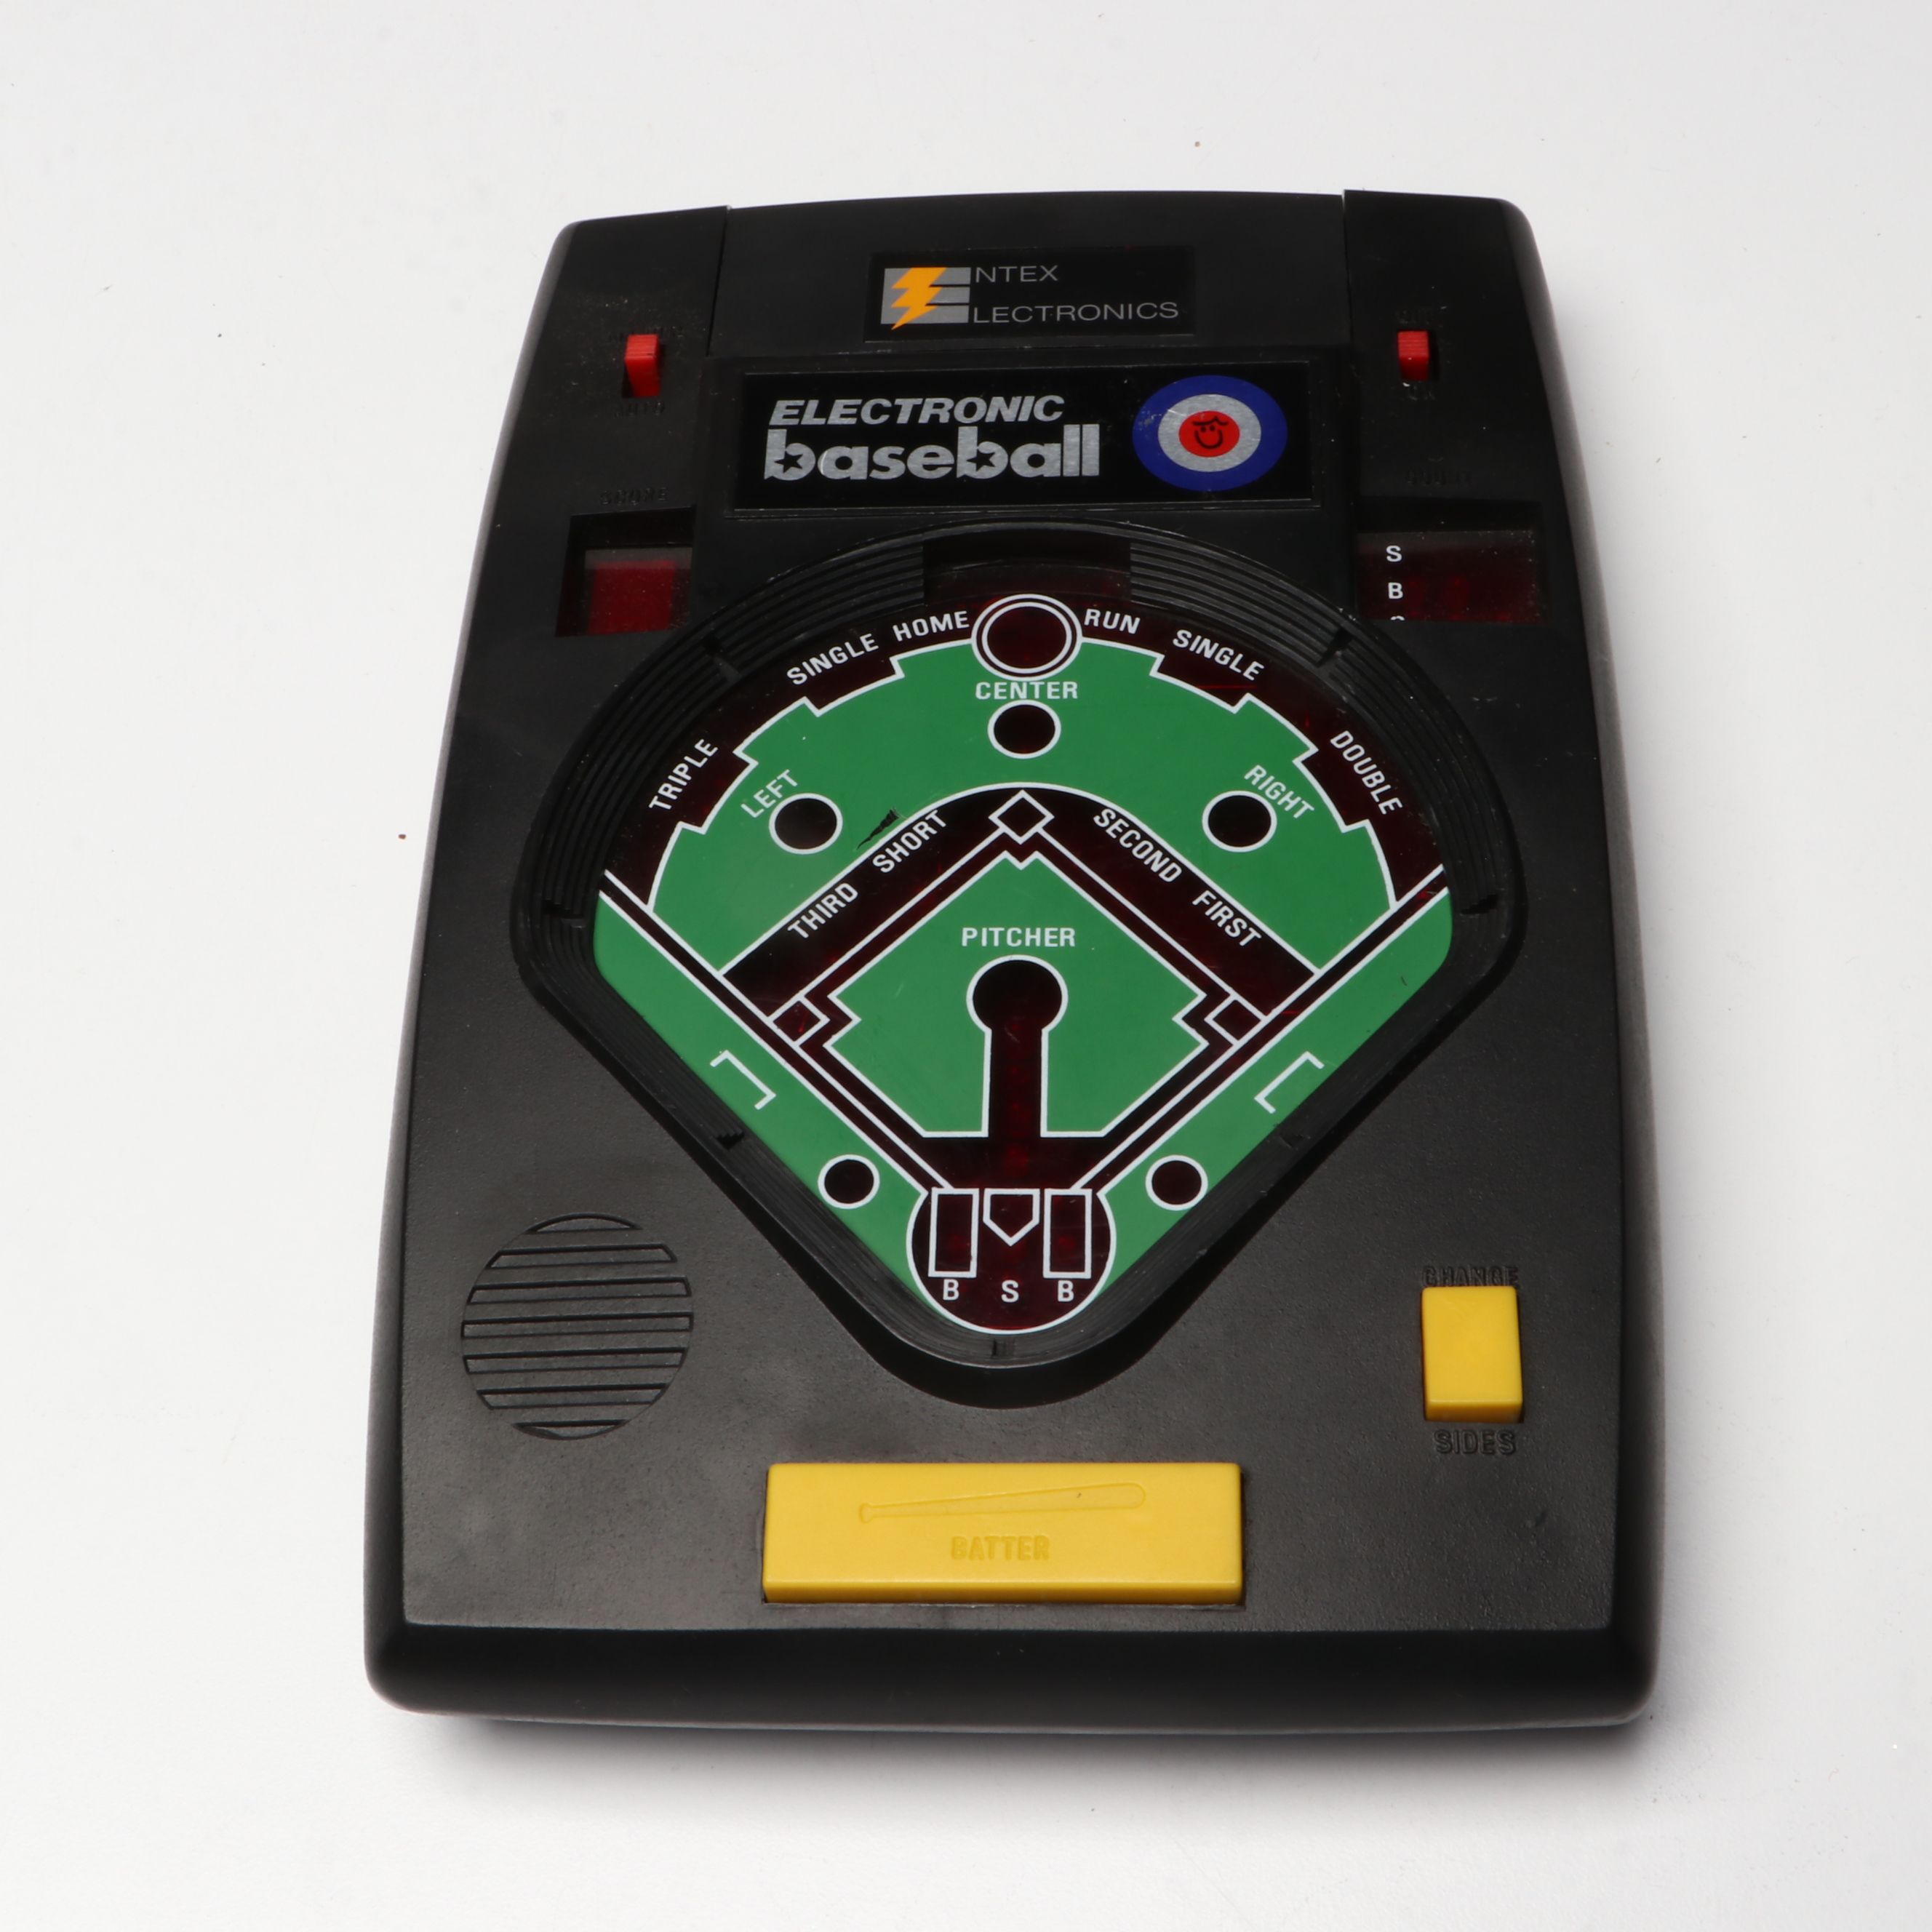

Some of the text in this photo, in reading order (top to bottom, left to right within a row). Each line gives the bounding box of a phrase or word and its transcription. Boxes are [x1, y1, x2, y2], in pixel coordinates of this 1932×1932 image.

[770, 396, 1064, 425] ELECTRONIC
[765, 424, 1099, 480] baseball
[1386, 546, 1402, 562] S
[1389, 583, 1402, 599] B
[893, 609, 1140, 641] HOME RUN
[787, 634, 878, 684] SINGLE
[1173, 630, 1264, 680] SINGLE
[975, 682, 1077, 699] CENTER
[649, 740, 717, 809] TRIPLE
[1330, 731, 1402, 814] DOUBLE
[741, 770, 797, 818] LEFT
[1245, 765, 1314, 818] RIGHT
[873, 810, 946, 872] SHORT
[1094, 809, 1181, 882] SECOND
[788, 884, 858, 938] THIRD
[1193, 890, 1261, 946] FIRST
[962, 927, 1075, 947] PITCHER
[943, 1279, 959, 1300] B
[1002, 1280, 1018, 1302] S
[1058, 1280, 1074, 1301] B
[1423, 1265, 1518, 1286] CHANGE
[1433, 1429, 1517, 1455] SIDES
[951, 1535, 1050, 1561] BATTER
